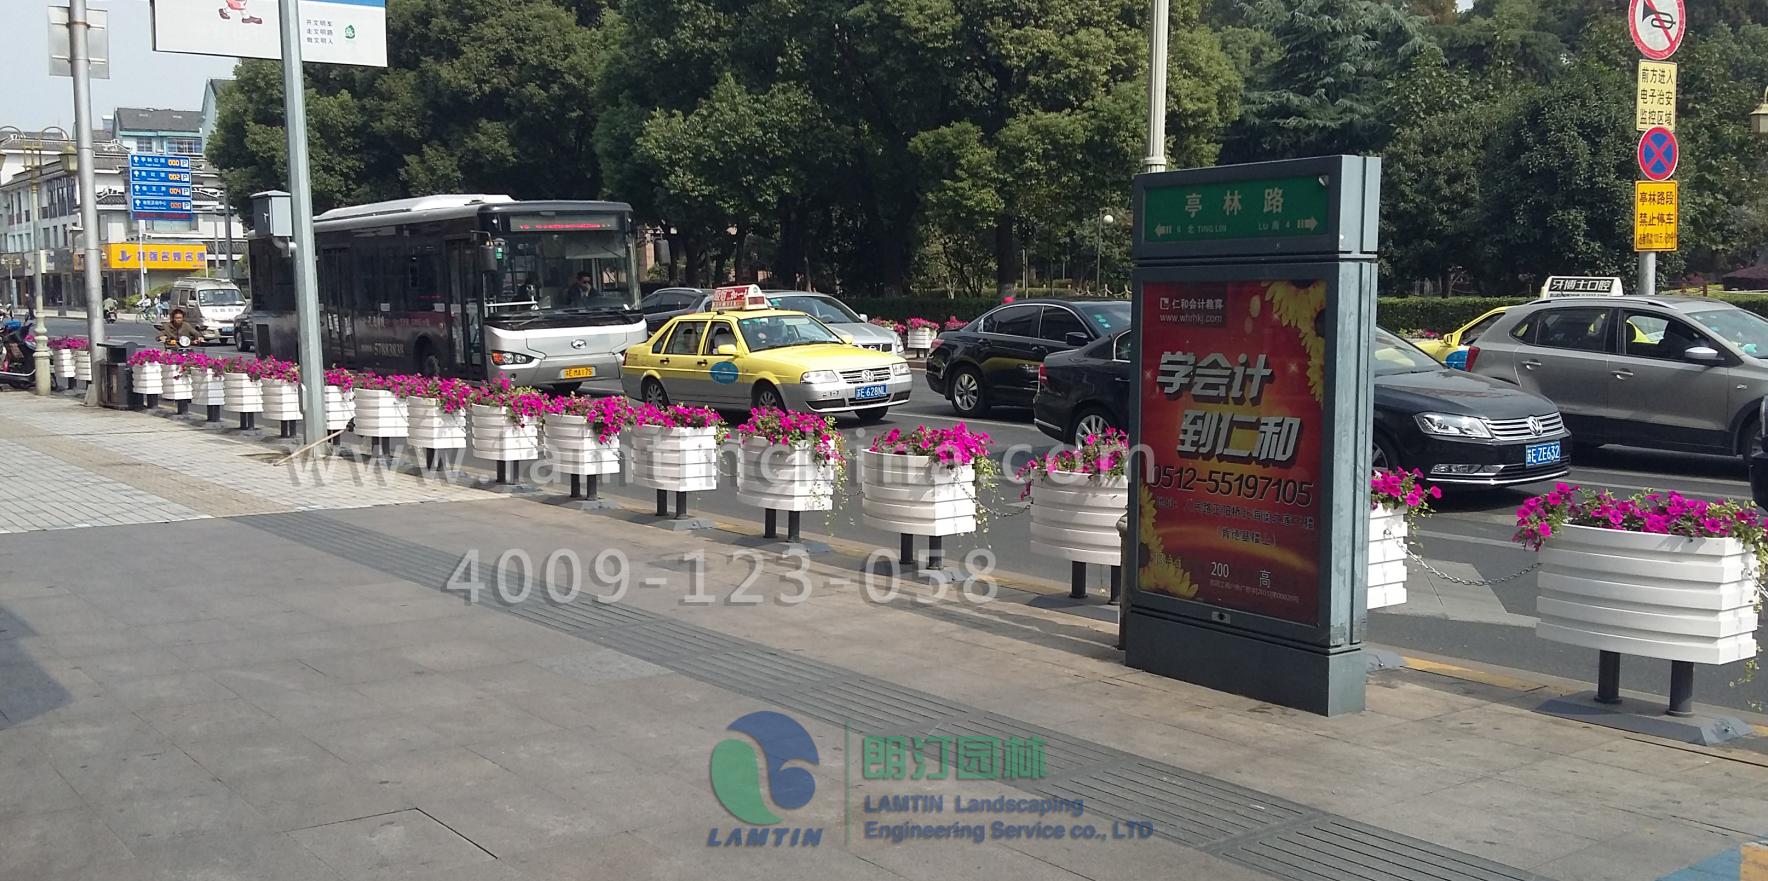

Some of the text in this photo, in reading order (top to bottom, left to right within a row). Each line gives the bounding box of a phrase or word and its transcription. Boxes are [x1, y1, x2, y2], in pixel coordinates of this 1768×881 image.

[1641, 66, 1673, 84] 前方进入
[1640, 88, 1673, 105] 电子治安
[1640, 109, 1673, 127] 监控区域
[1185, 187, 1284, 219] 亭林路
[1639, 191, 1674, 206] 亭林路段
[1639, 212, 1674, 227] 禁止停车
[1551, 279, 1612, 291] 牙博士口腔
[1172, 298, 1224, 310] 仁和会计教育
[1157, 352, 1274, 400] 学会计
[1177, 409, 1301, 463] 到仁和
[1151, 465, 1314, 509] 0512-55197105
[1211, 561, 1230, 579] 200
[1259, 569, 1272, 588] 高
